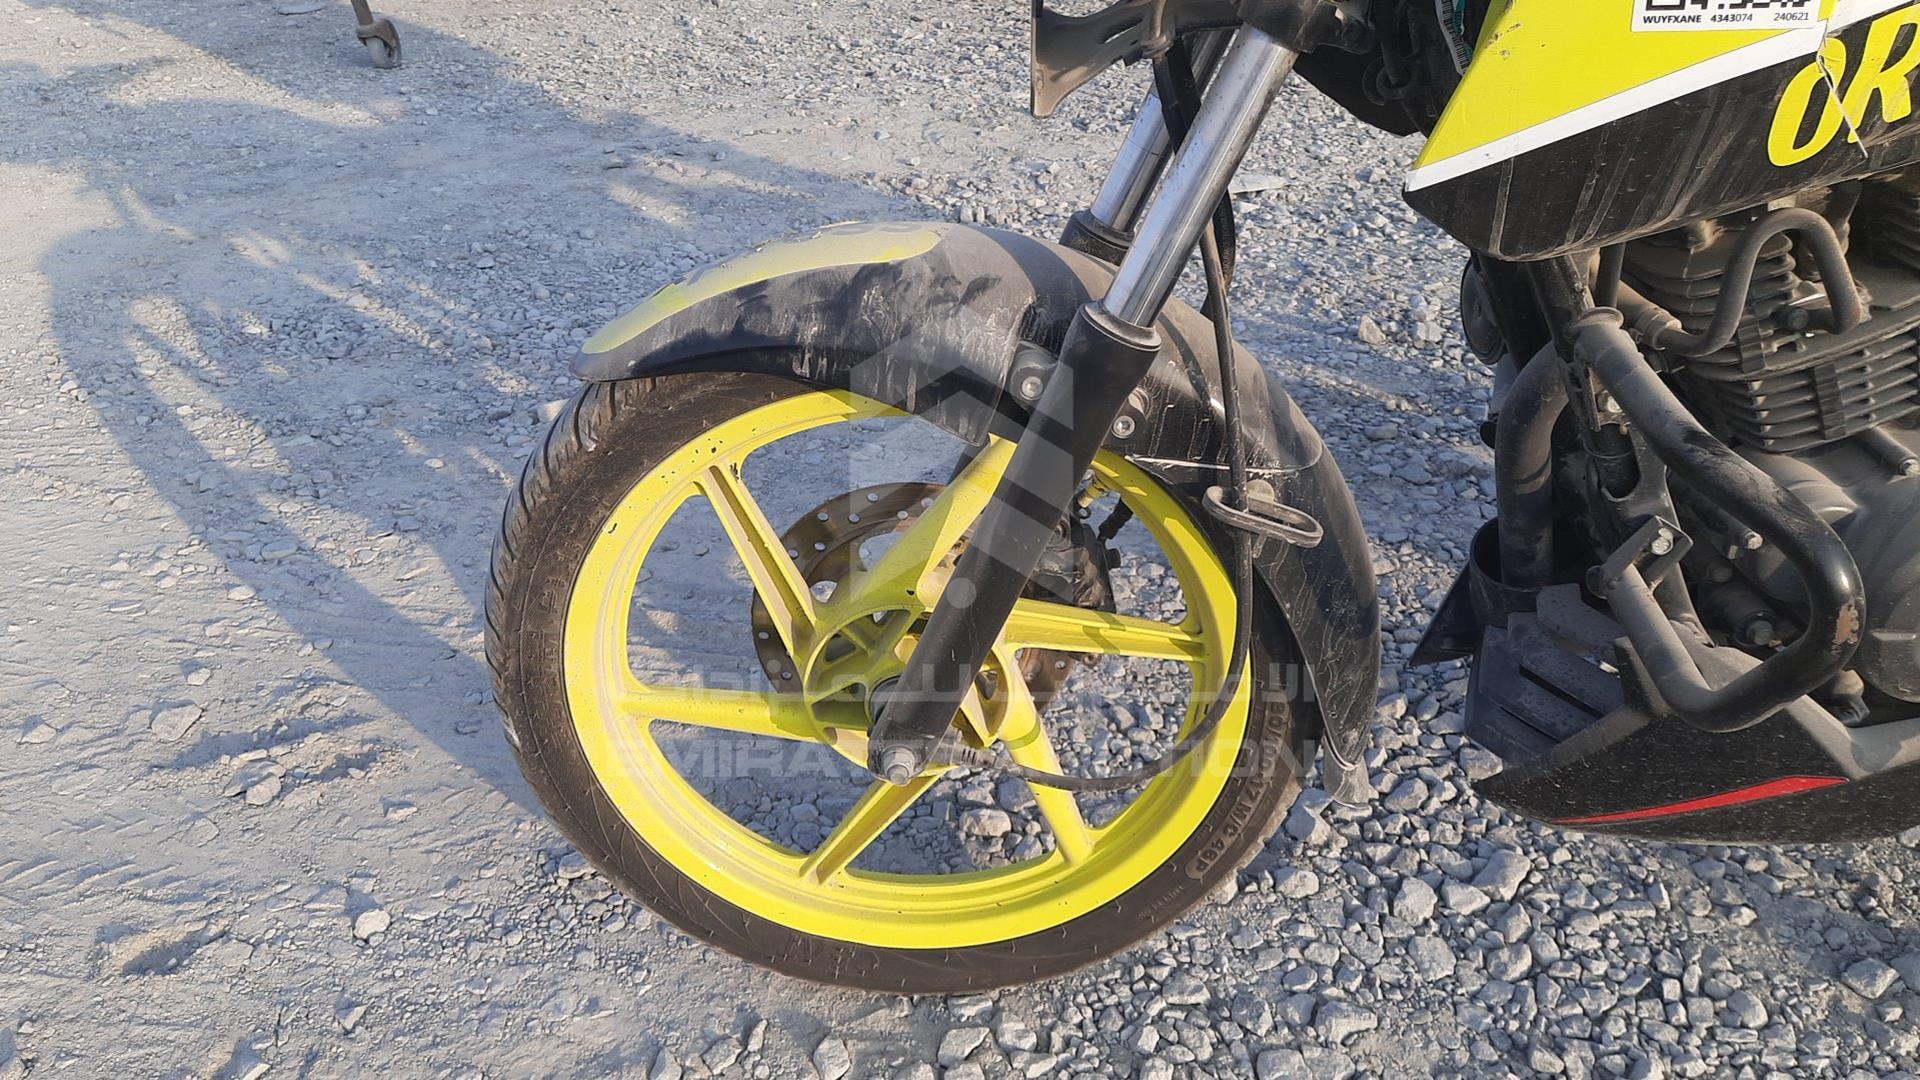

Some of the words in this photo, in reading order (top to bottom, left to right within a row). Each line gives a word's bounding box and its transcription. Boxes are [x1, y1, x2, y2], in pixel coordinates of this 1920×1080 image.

[1642, 14, 1702, 24] WUYFXANE
[1710, 13, 1753, 23] 4343074
[1773, 12, 1809, 22] 240621
